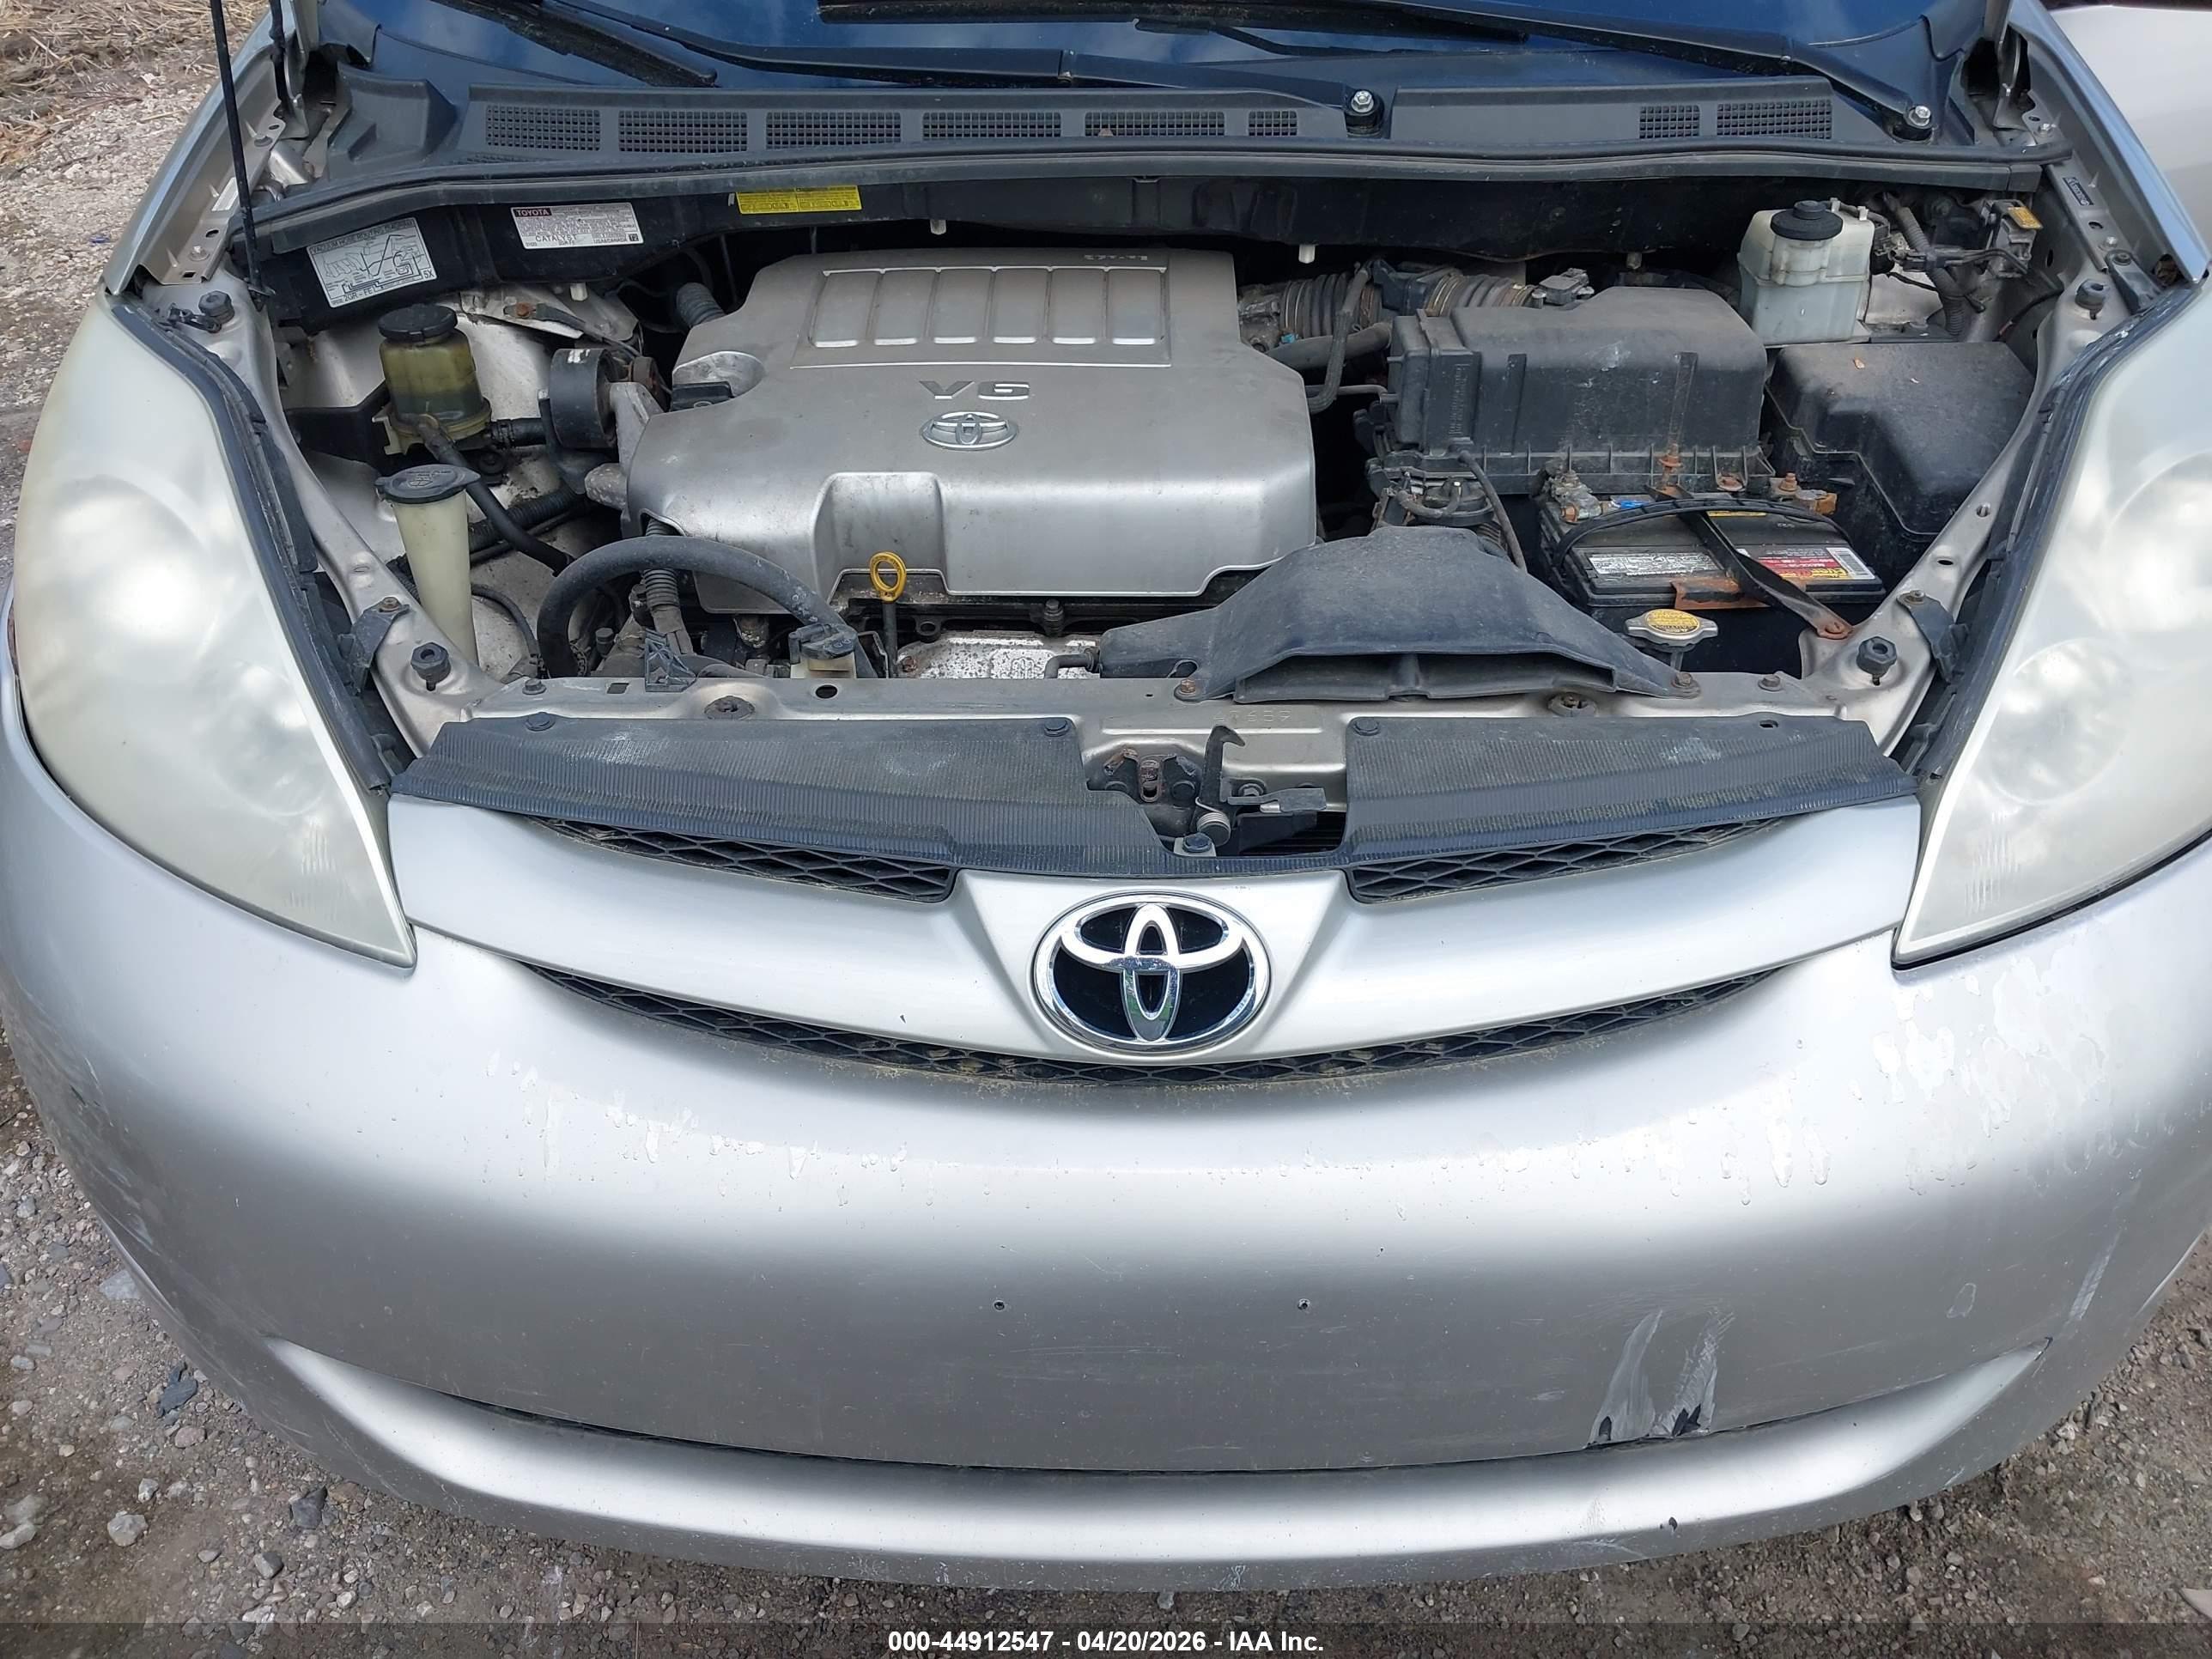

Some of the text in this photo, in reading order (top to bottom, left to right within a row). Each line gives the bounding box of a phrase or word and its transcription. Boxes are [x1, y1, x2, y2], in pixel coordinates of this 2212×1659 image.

[536, 234, 577, 242] CATALYST
[424, 270, 434, 279] 5X
[919, 380, 1030, 400] V6
